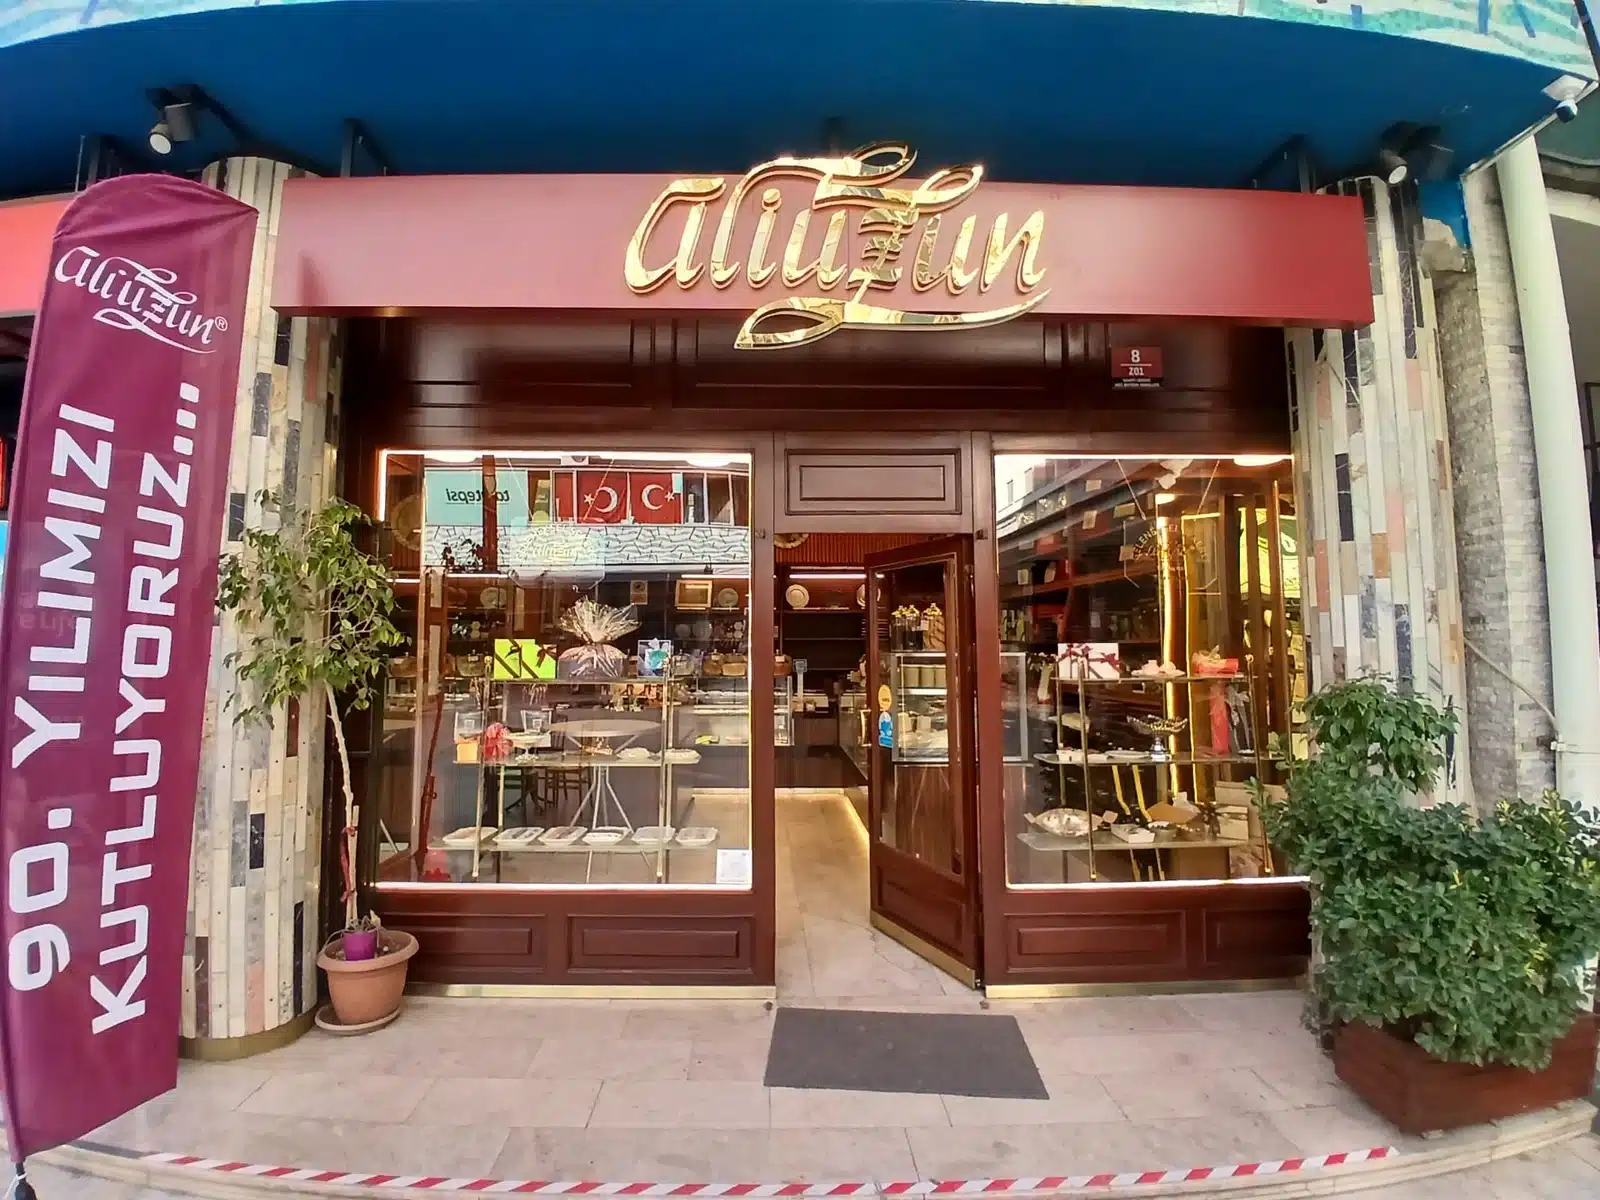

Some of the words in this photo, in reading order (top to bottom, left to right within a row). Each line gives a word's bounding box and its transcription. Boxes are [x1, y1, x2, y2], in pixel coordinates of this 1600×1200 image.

[1131, 349, 1140, 363] 8
[12, 403, 115, 769] YILIMIZI
[8, 807, 73, 992] 90.
